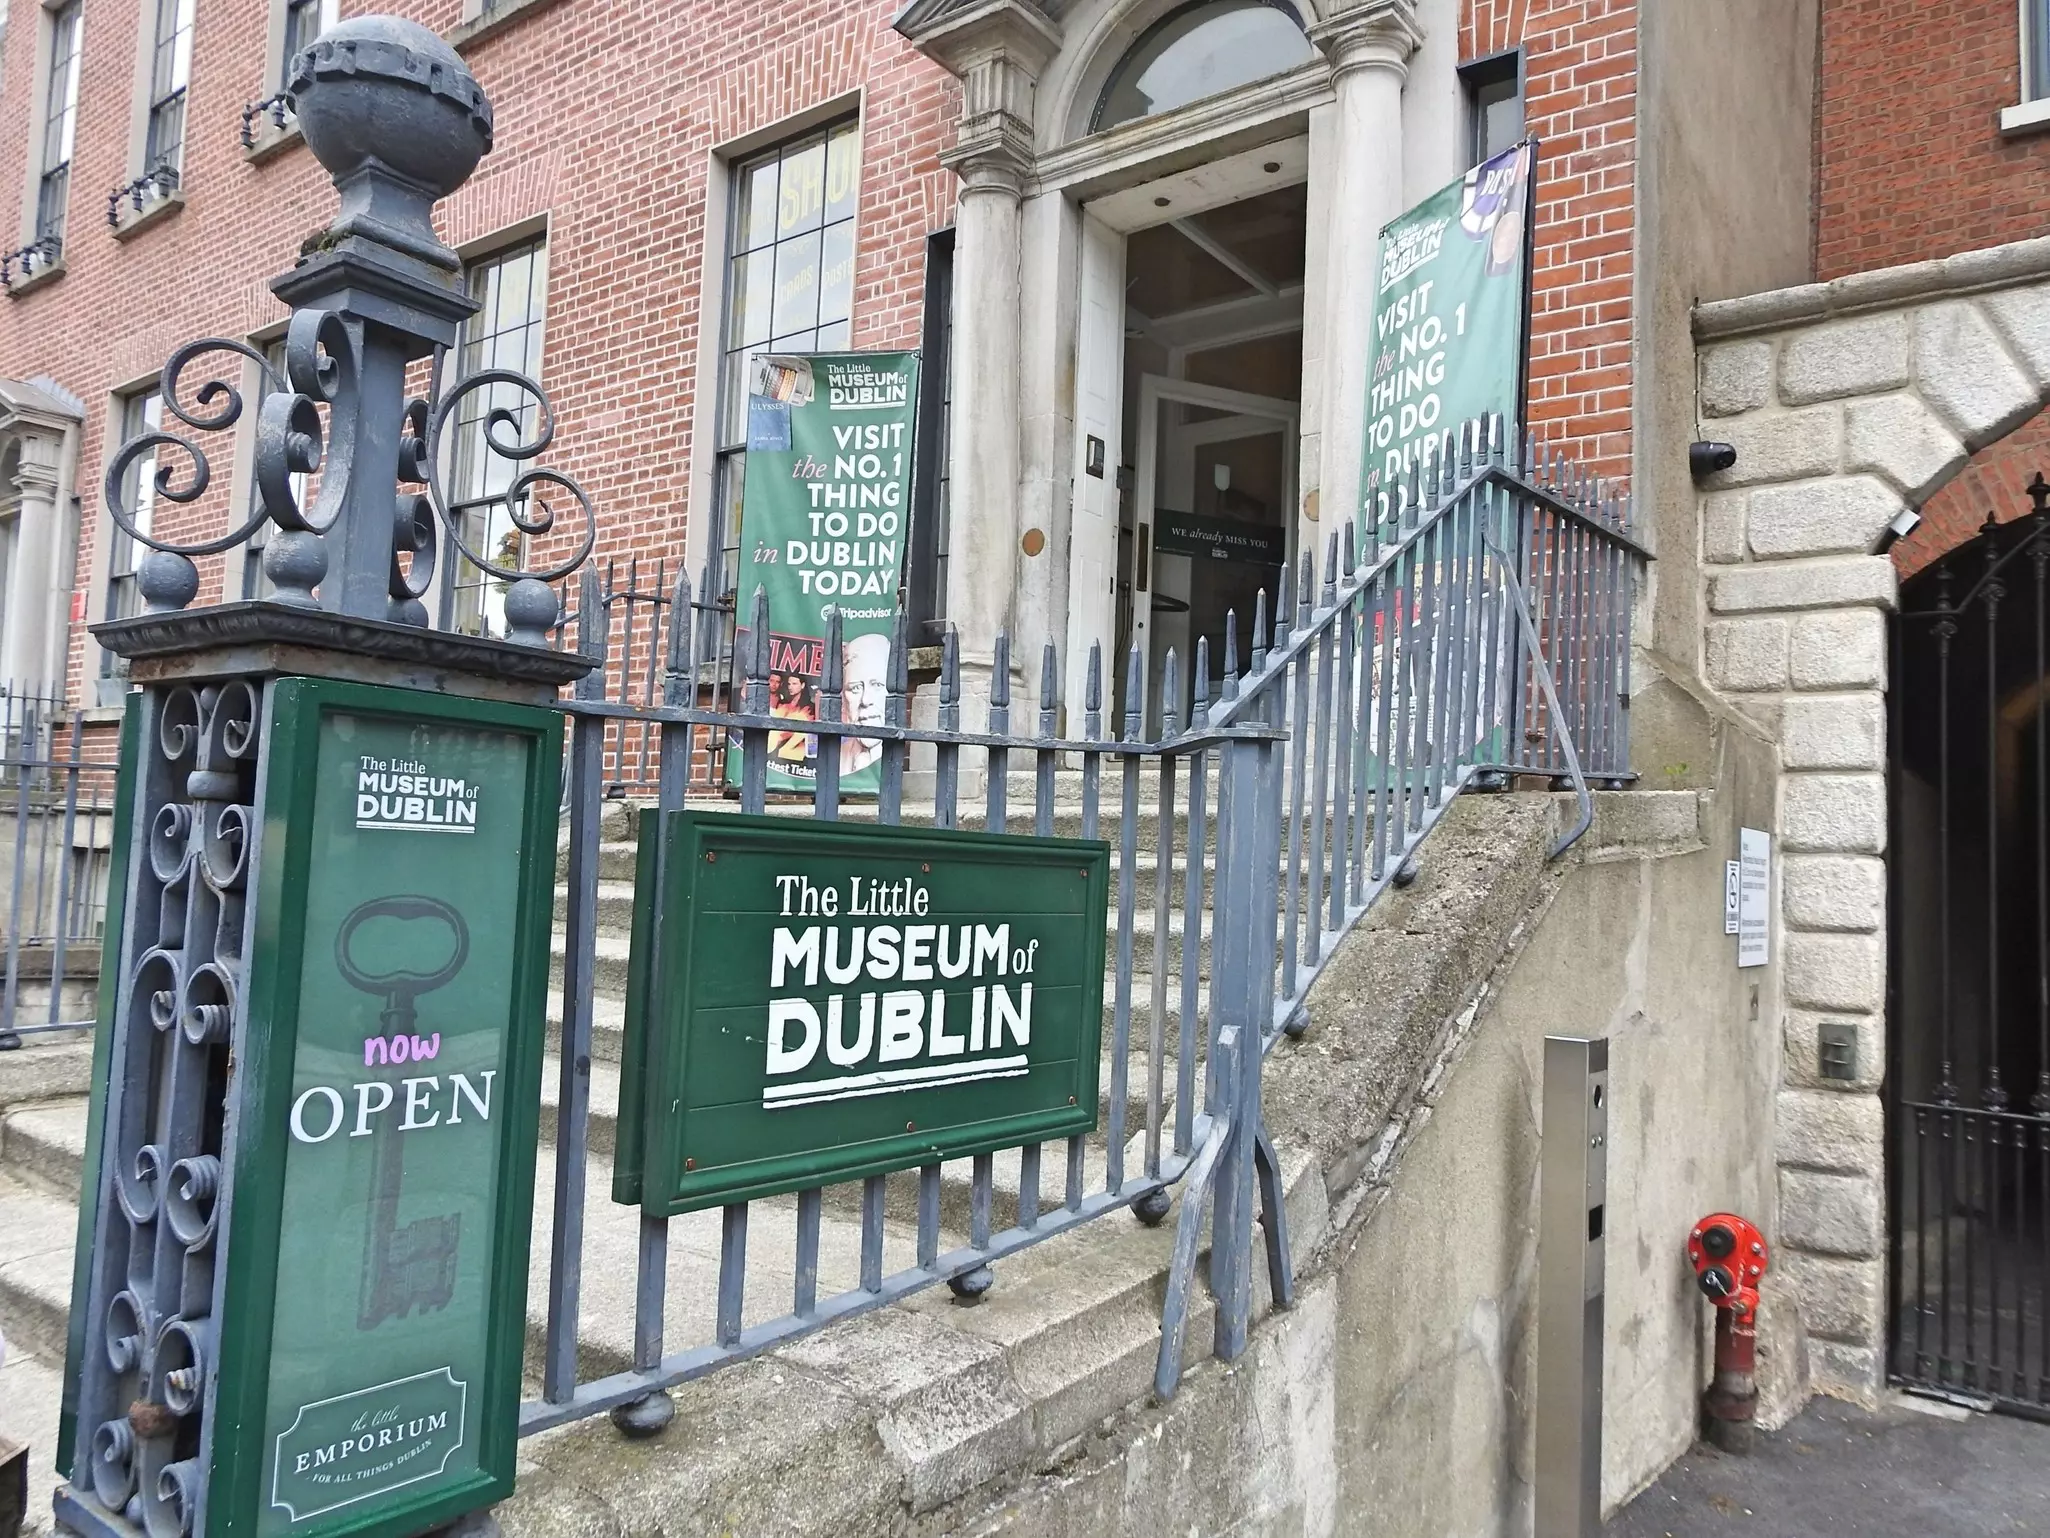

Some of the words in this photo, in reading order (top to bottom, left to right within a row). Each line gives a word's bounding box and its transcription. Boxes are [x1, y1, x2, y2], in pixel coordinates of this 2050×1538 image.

[1380, 229, 1444, 288] DUBLIN
[1377, 280, 1433, 341] VISIT
[1400, 315, 1448, 364] NO.
[1455, 302, 1466, 336] 1
[827, 364, 845, 374] The
[846, 363, 871, 373] Little
[1373, 345, 1396, 382] the
[828, 373, 897, 388] MUSEUM
[898, 373, 908, 384] of
[830, 384, 906, 404] DUBLIN
[1371, 351, 1445, 417] THING
[751, 403, 785, 411] ULYSSES
[832, 422, 905, 450] VISIT
[1368, 414, 1394, 454] TO
[1400, 392, 1440, 439] DO
[792, 454, 827, 479] the
[834, 454, 887, 480] NO.
[893, 453, 902, 477] 1
[807, 481, 900, 509] THING
[808, 511, 849, 538] TO
[857, 511, 898, 538] DO
[1171, 527, 1187, 537] WE
[1189, 528, 1223, 546] already
[1225, 535, 1247, 546] MISS
[1250, 539, 1268, 549] YOU
[753, 541, 777, 564] in
[786, 540, 896, 567] DUBLIN
[798, 569, 894, 596] TODAY
[839, 607, 892, 620] Tripadvisor
[361, 755, 387, 771] The
[391, 758, 426, 774] Little
[358, 771, 465, 798] MUSEUM
[465, 785, 480, 799] of
[356, 794, 477, 824] DUBLIN
[775, 875, 839, 917] The
[847, 876, 929, 917] Little
[770, 923, 1010, 988] MUSEUM
[1012, 938, 1039, 975] of
[765, 982, 1033, 1075] DUBLIN
[363, 1031, 441, 1067] now
[289, 1069, 497, 1144] OPEN
[350, 1411, 368, 1432] the
[371, 1405, 400, 1428] little
[293, 1411, 447, 1475] EMPORIUM
[312, 1473, 331, 1484] FOR
[333, 1473, 353, 1484] ALL
[356, 1460, 394, 1480] THINGS
[396, 1438, 432, 1466] DUBLIN
